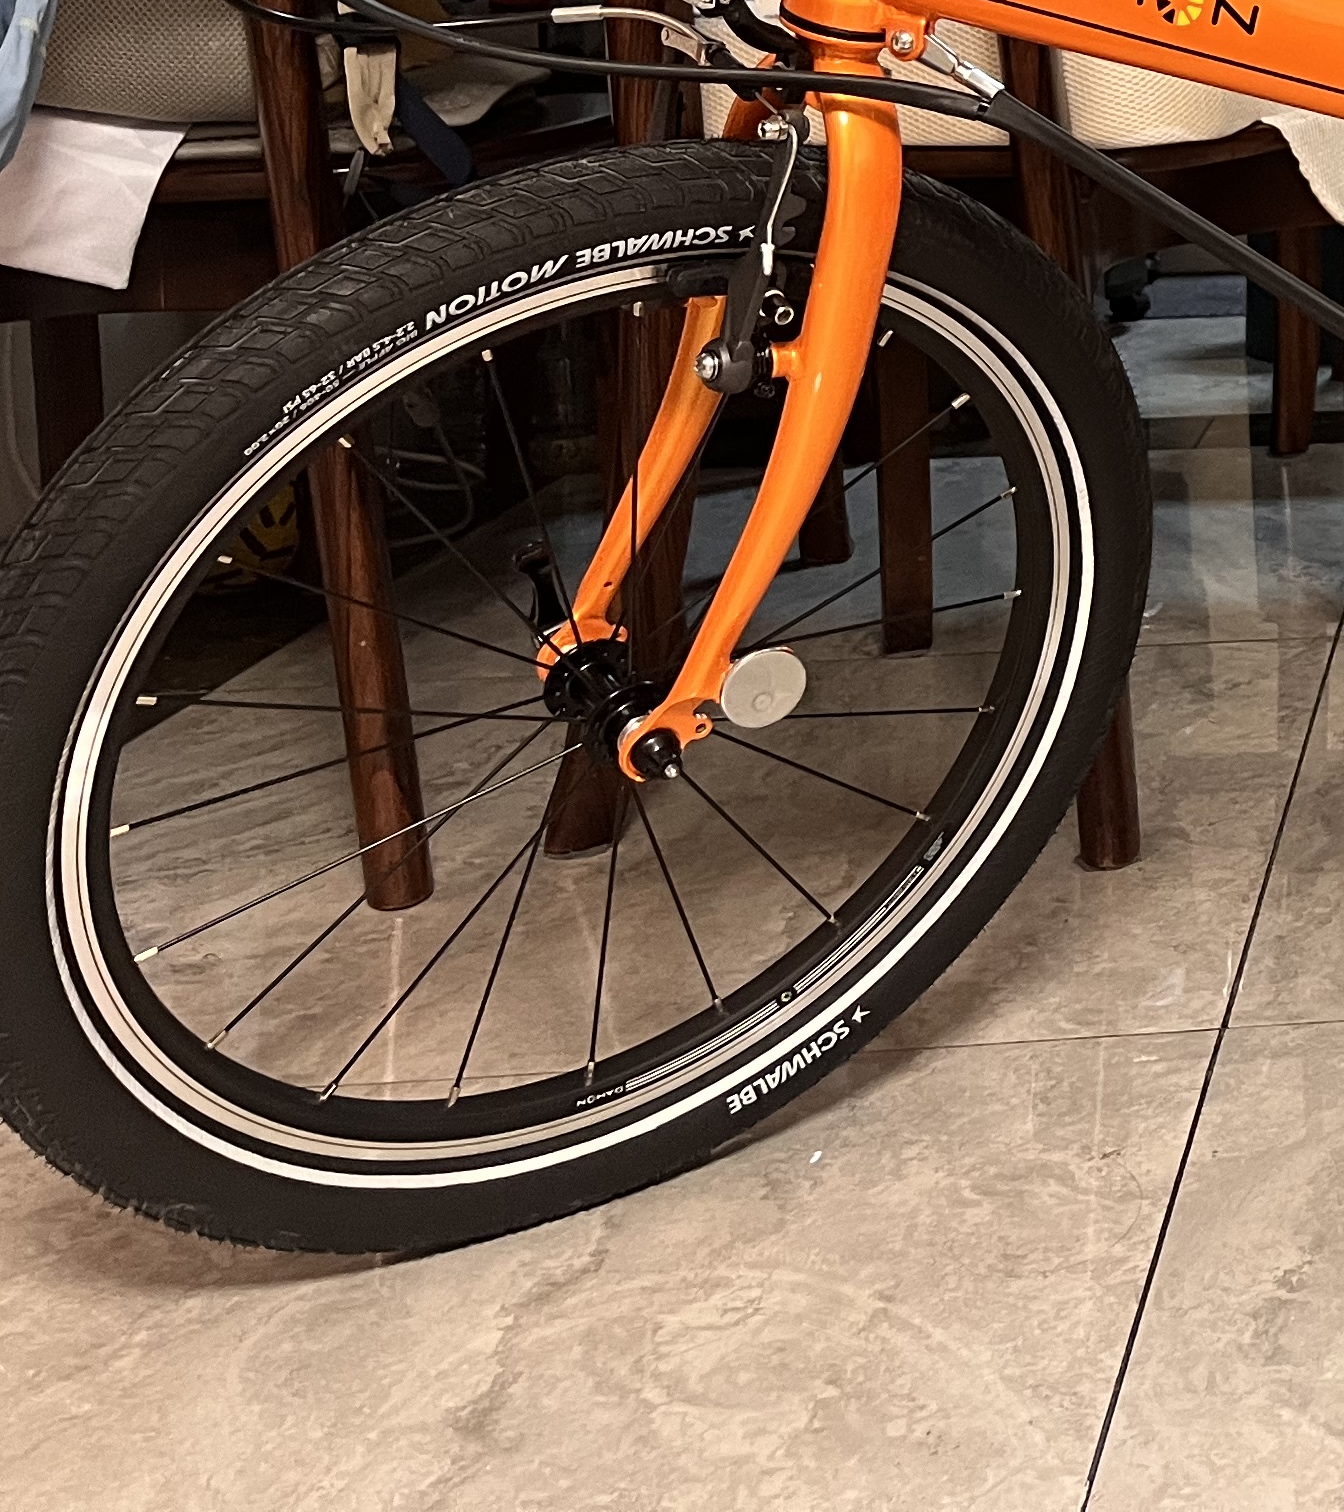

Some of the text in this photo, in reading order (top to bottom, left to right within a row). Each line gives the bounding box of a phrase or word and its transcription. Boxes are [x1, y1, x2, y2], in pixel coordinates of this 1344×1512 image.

[422, 223, 734, 331] SCHWALBE MOTION
[575, 1084, 625, 1108] DAHON
[725, 1017, 852, 1116] SCHWALBE
